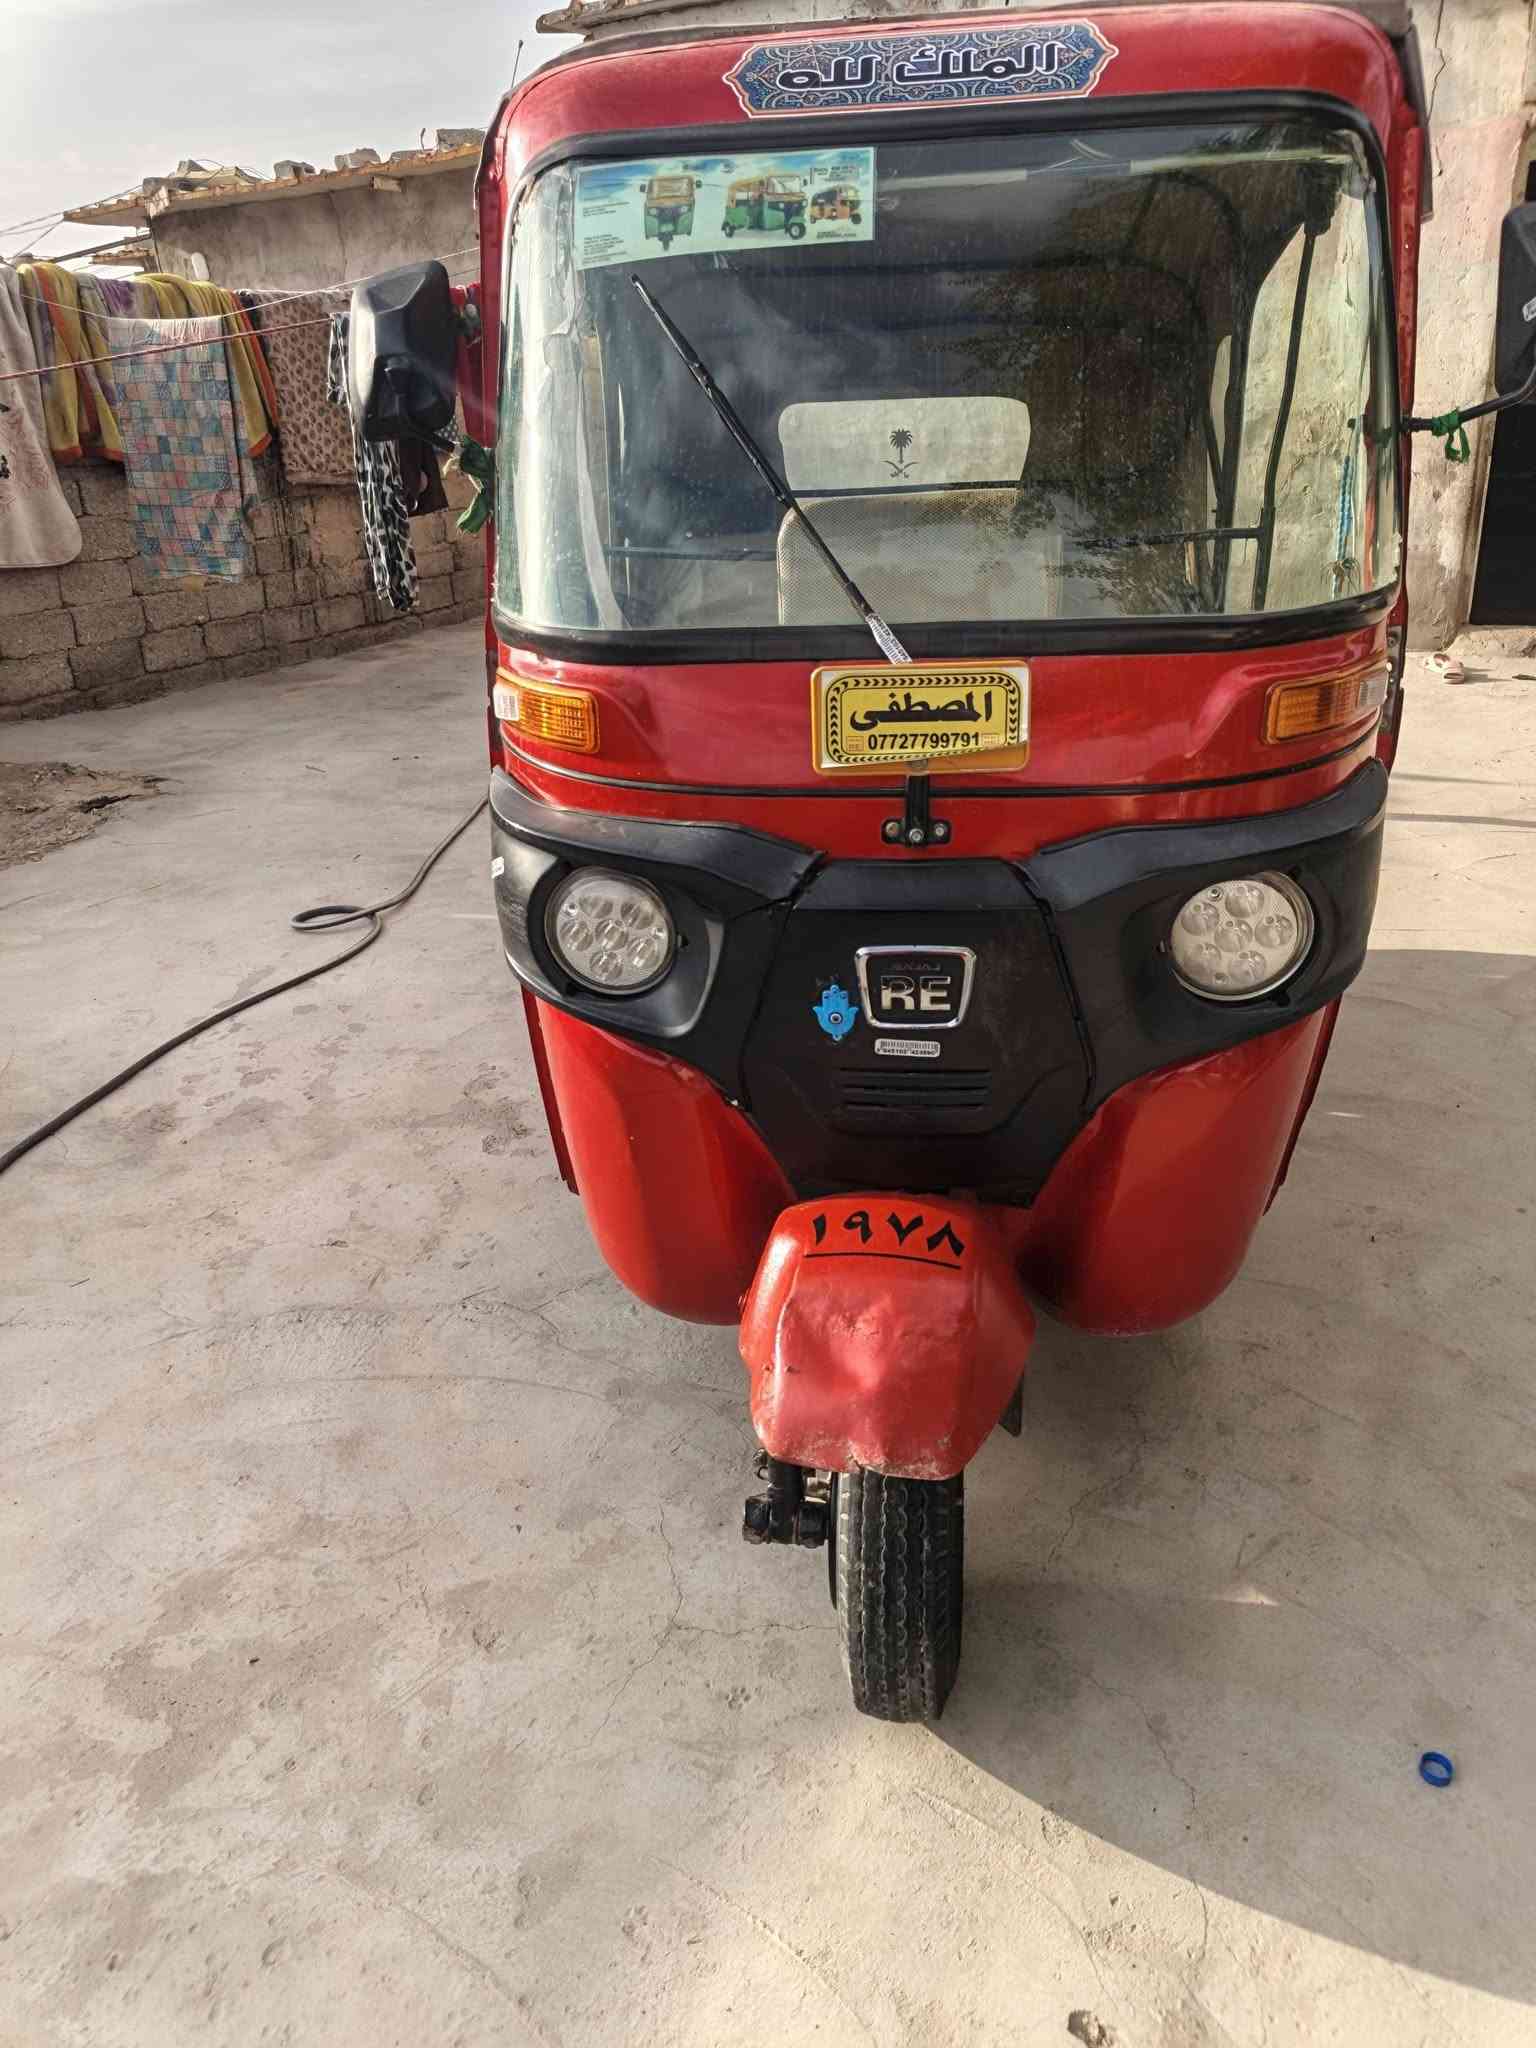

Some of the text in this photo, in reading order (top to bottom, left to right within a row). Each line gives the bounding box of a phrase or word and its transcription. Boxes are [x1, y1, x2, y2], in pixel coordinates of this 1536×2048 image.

[776, 42, 1064, 91] الملك لله
[850, 690, 993, 731] المصطفى
[868, 732, 980, 751] 07727799791
[880, 975, 951, 1010] RE
[812, 1210, 965, 1257] ١٩٧٨
